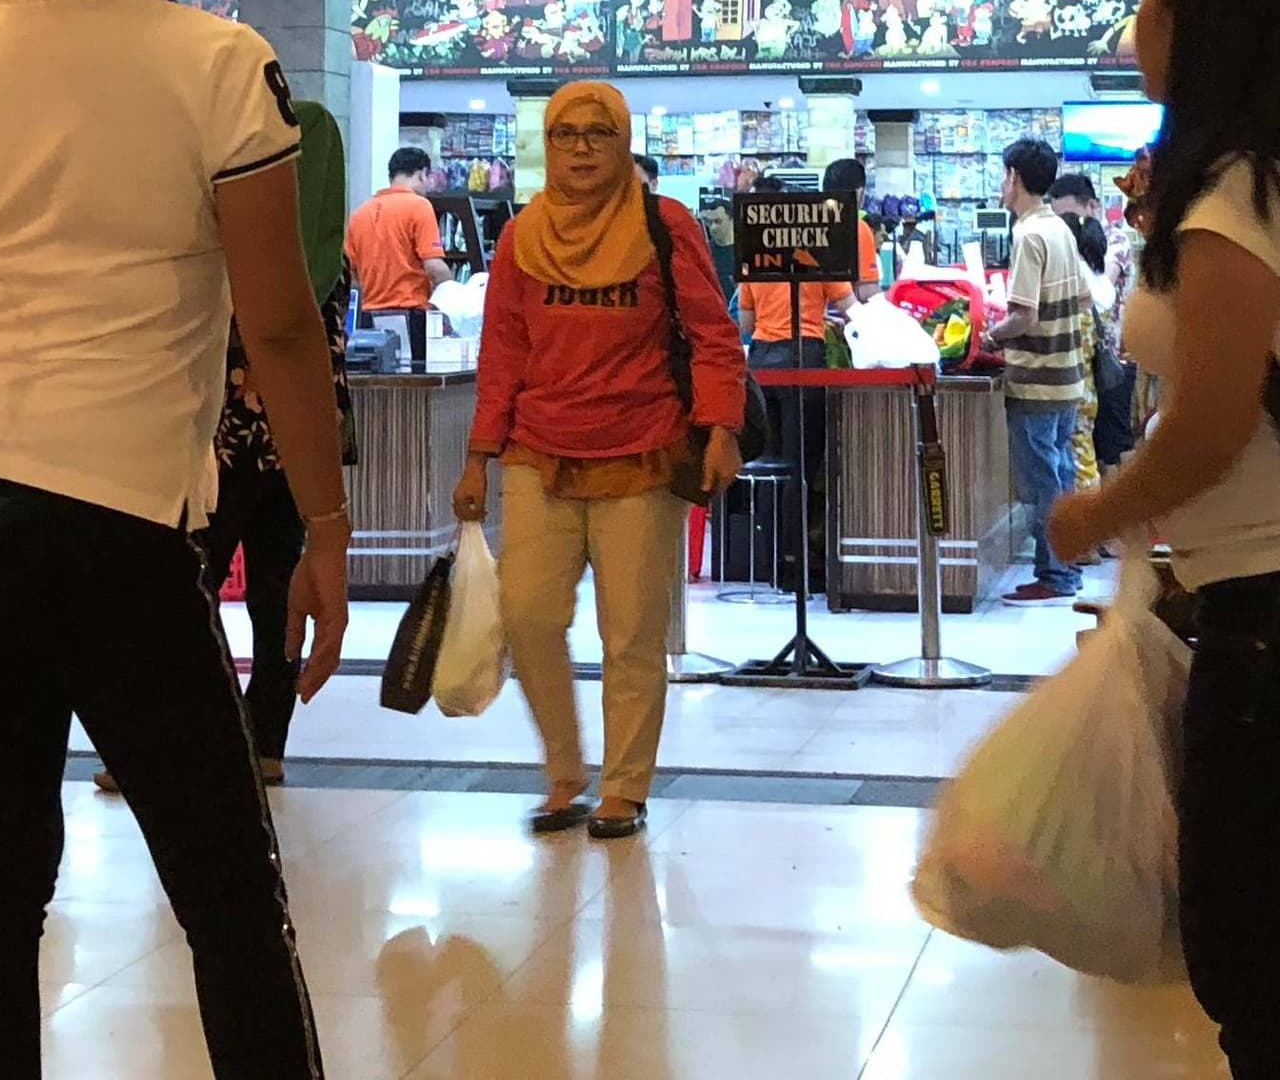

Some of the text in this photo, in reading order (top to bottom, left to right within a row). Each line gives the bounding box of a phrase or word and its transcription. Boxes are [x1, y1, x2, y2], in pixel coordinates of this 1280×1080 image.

[746, 201, 845, 225] SECURITY
[762, 226, 830, 248] CHECK
[754, 253, 783, 268] IN
